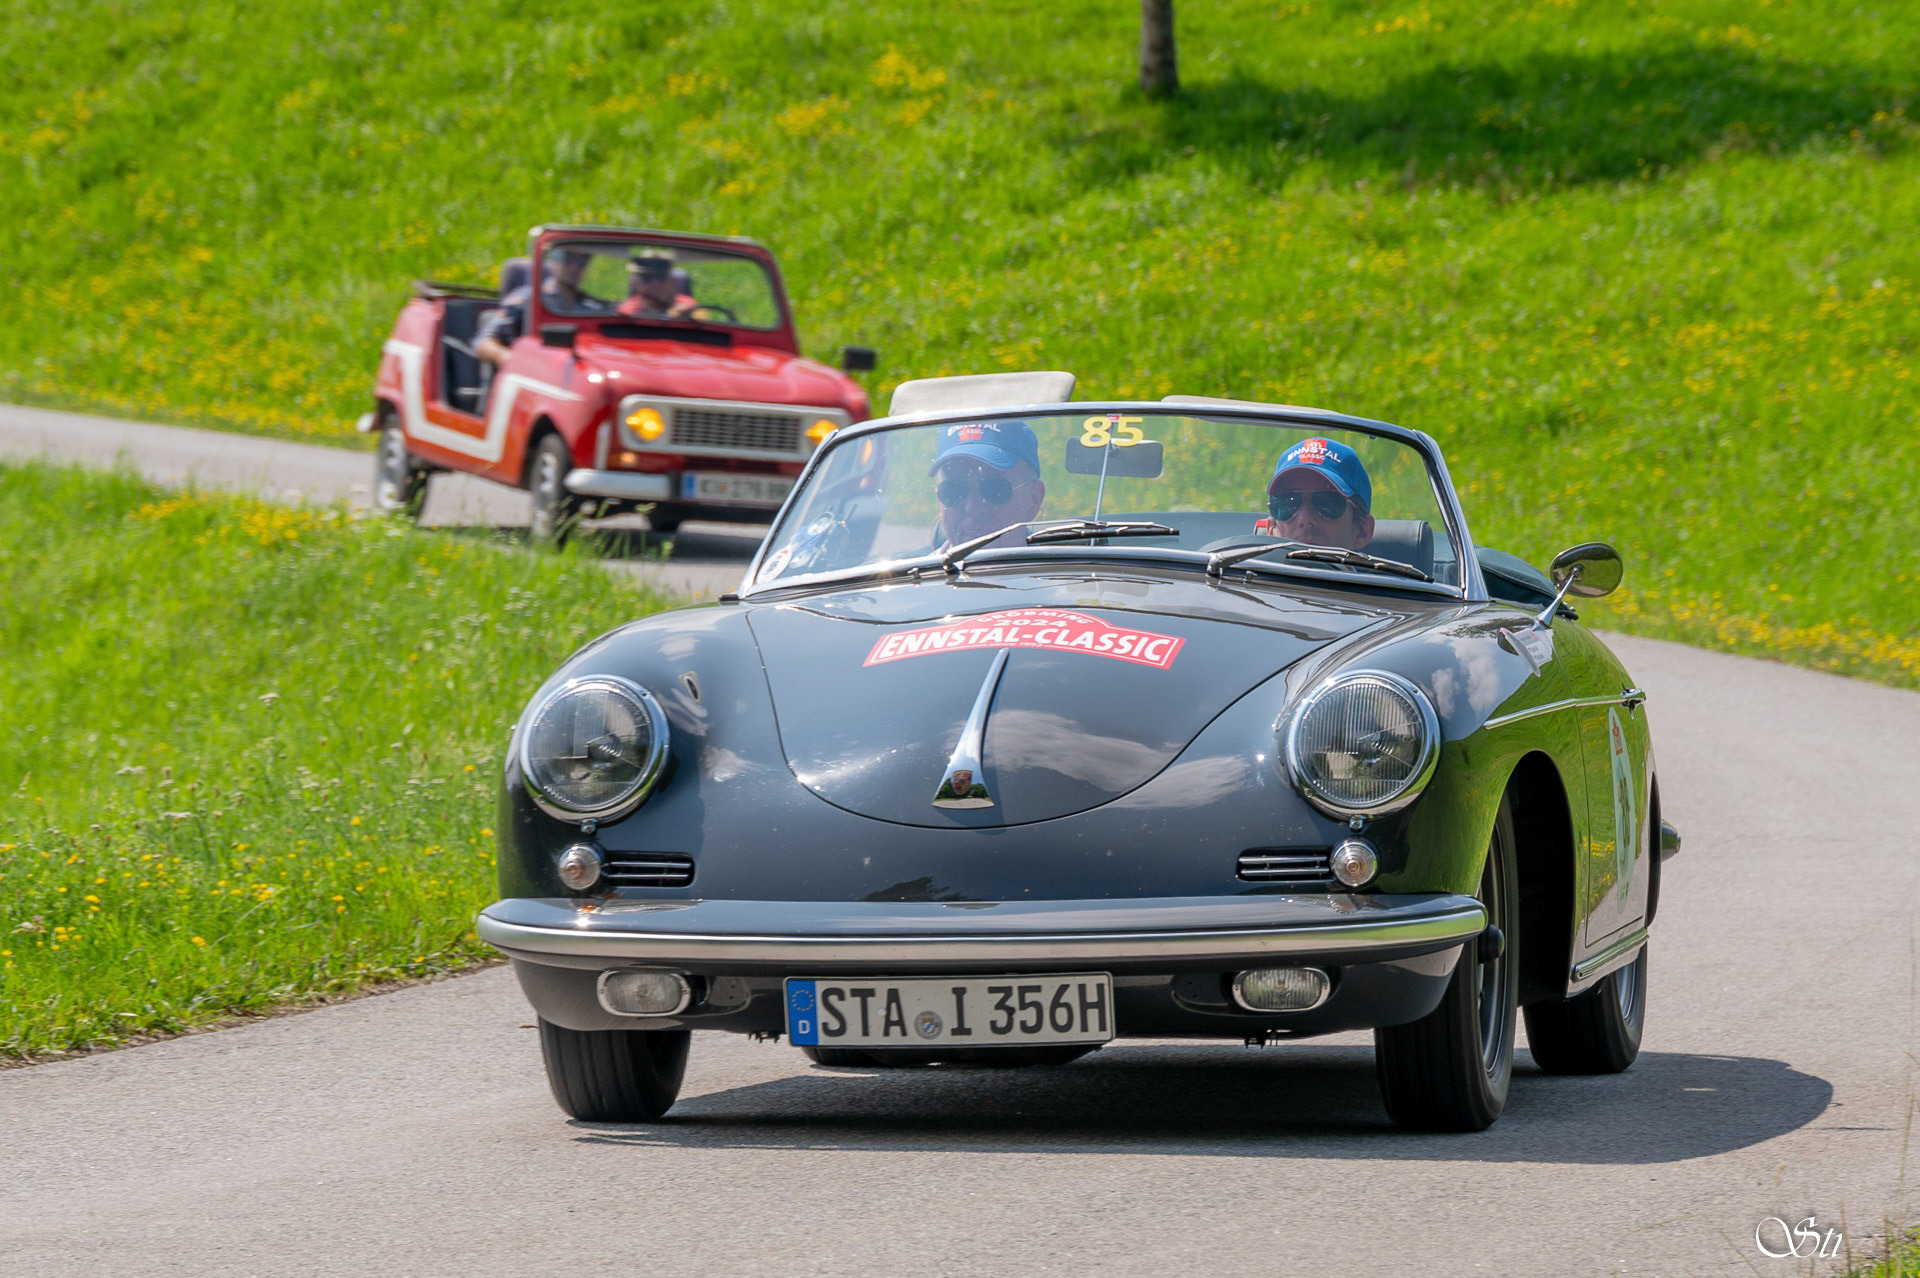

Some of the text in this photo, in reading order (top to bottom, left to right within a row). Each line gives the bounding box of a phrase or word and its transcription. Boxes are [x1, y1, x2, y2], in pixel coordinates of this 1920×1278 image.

[1080, 416, 1144, 447] 85
[1287, 447, 1341, 463] ENNSTAL
[993, 619, 1067, 628] 2024
[878, 627, 1171, 661] ENNSTAL-CLASSIC
[821, 987, 907, 1038] STA
[987, 983, 1107, 1036] 356H
[798, 1020, 810, 1034] D
